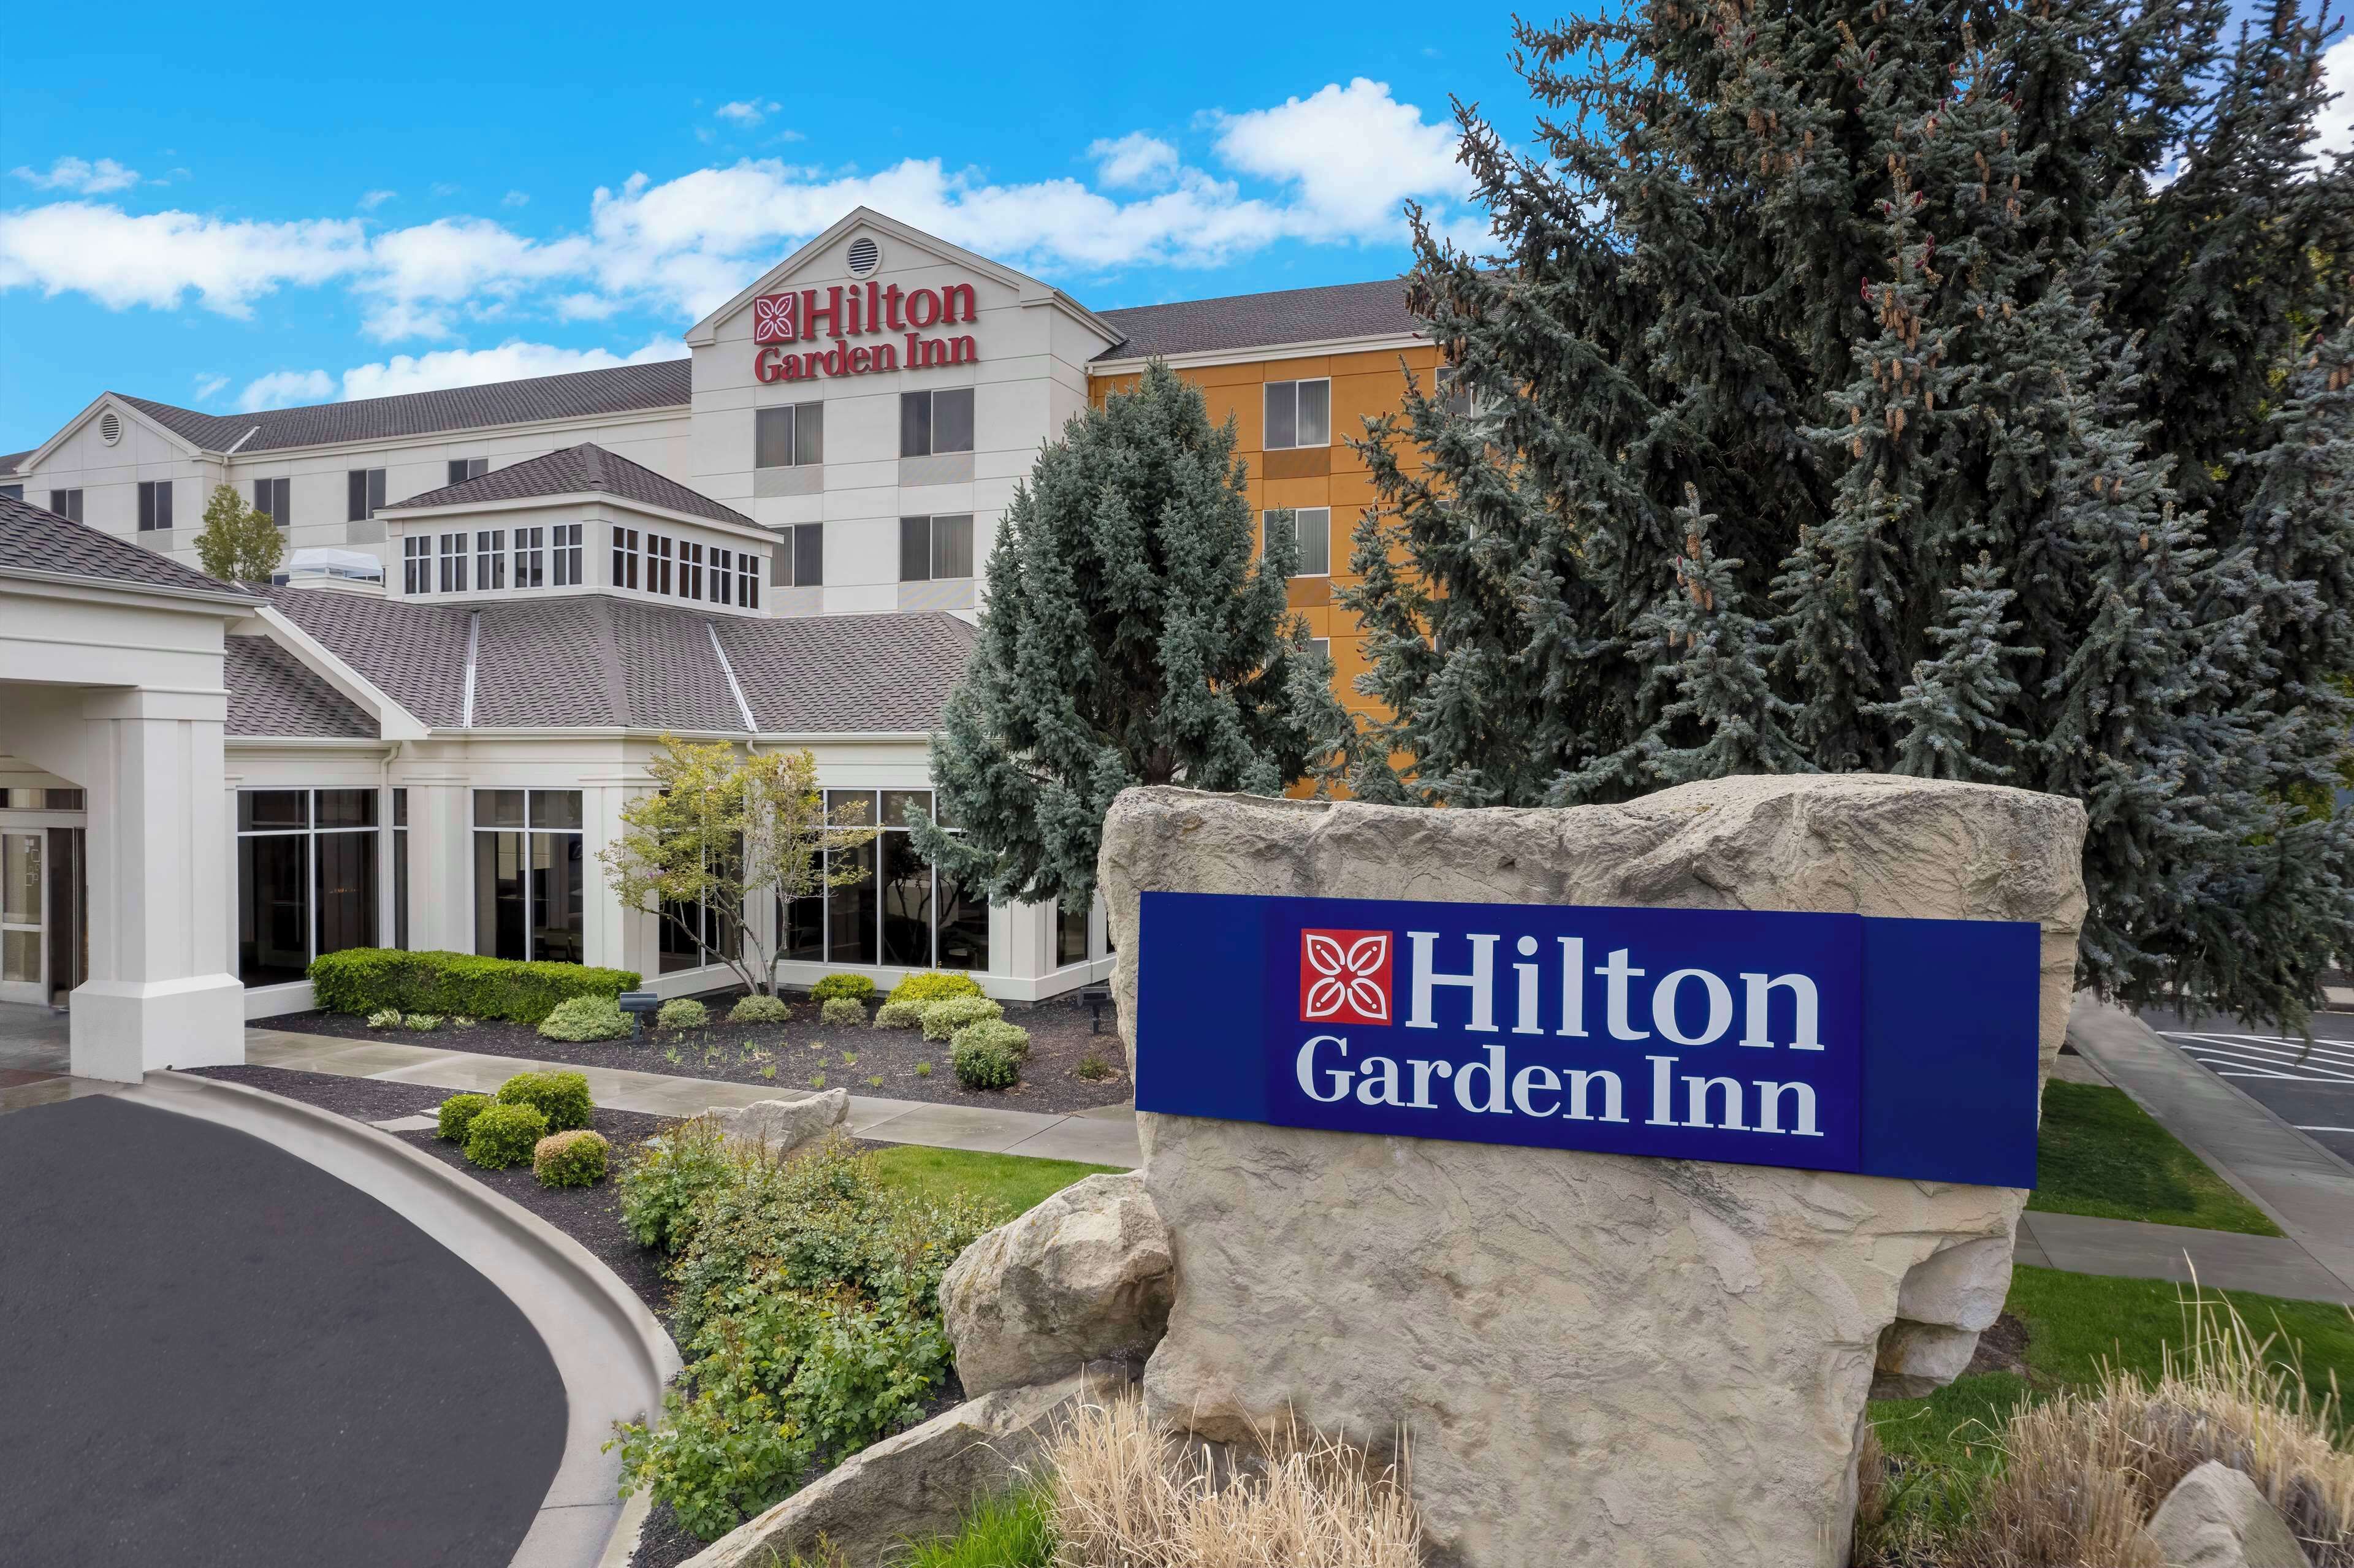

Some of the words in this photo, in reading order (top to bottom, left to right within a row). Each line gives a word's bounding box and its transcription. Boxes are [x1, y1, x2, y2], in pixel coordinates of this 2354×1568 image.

[801, 281, 977, 340] Hilton
[755, 340, 898, 383] Garden
[904, 332, 978, 369] Inn
[1405, 931, 1825, 1051] Hilton
[1296, 1035, 1630, 1124] Garden
[1644, 1054, 1824, 1137] Inn
